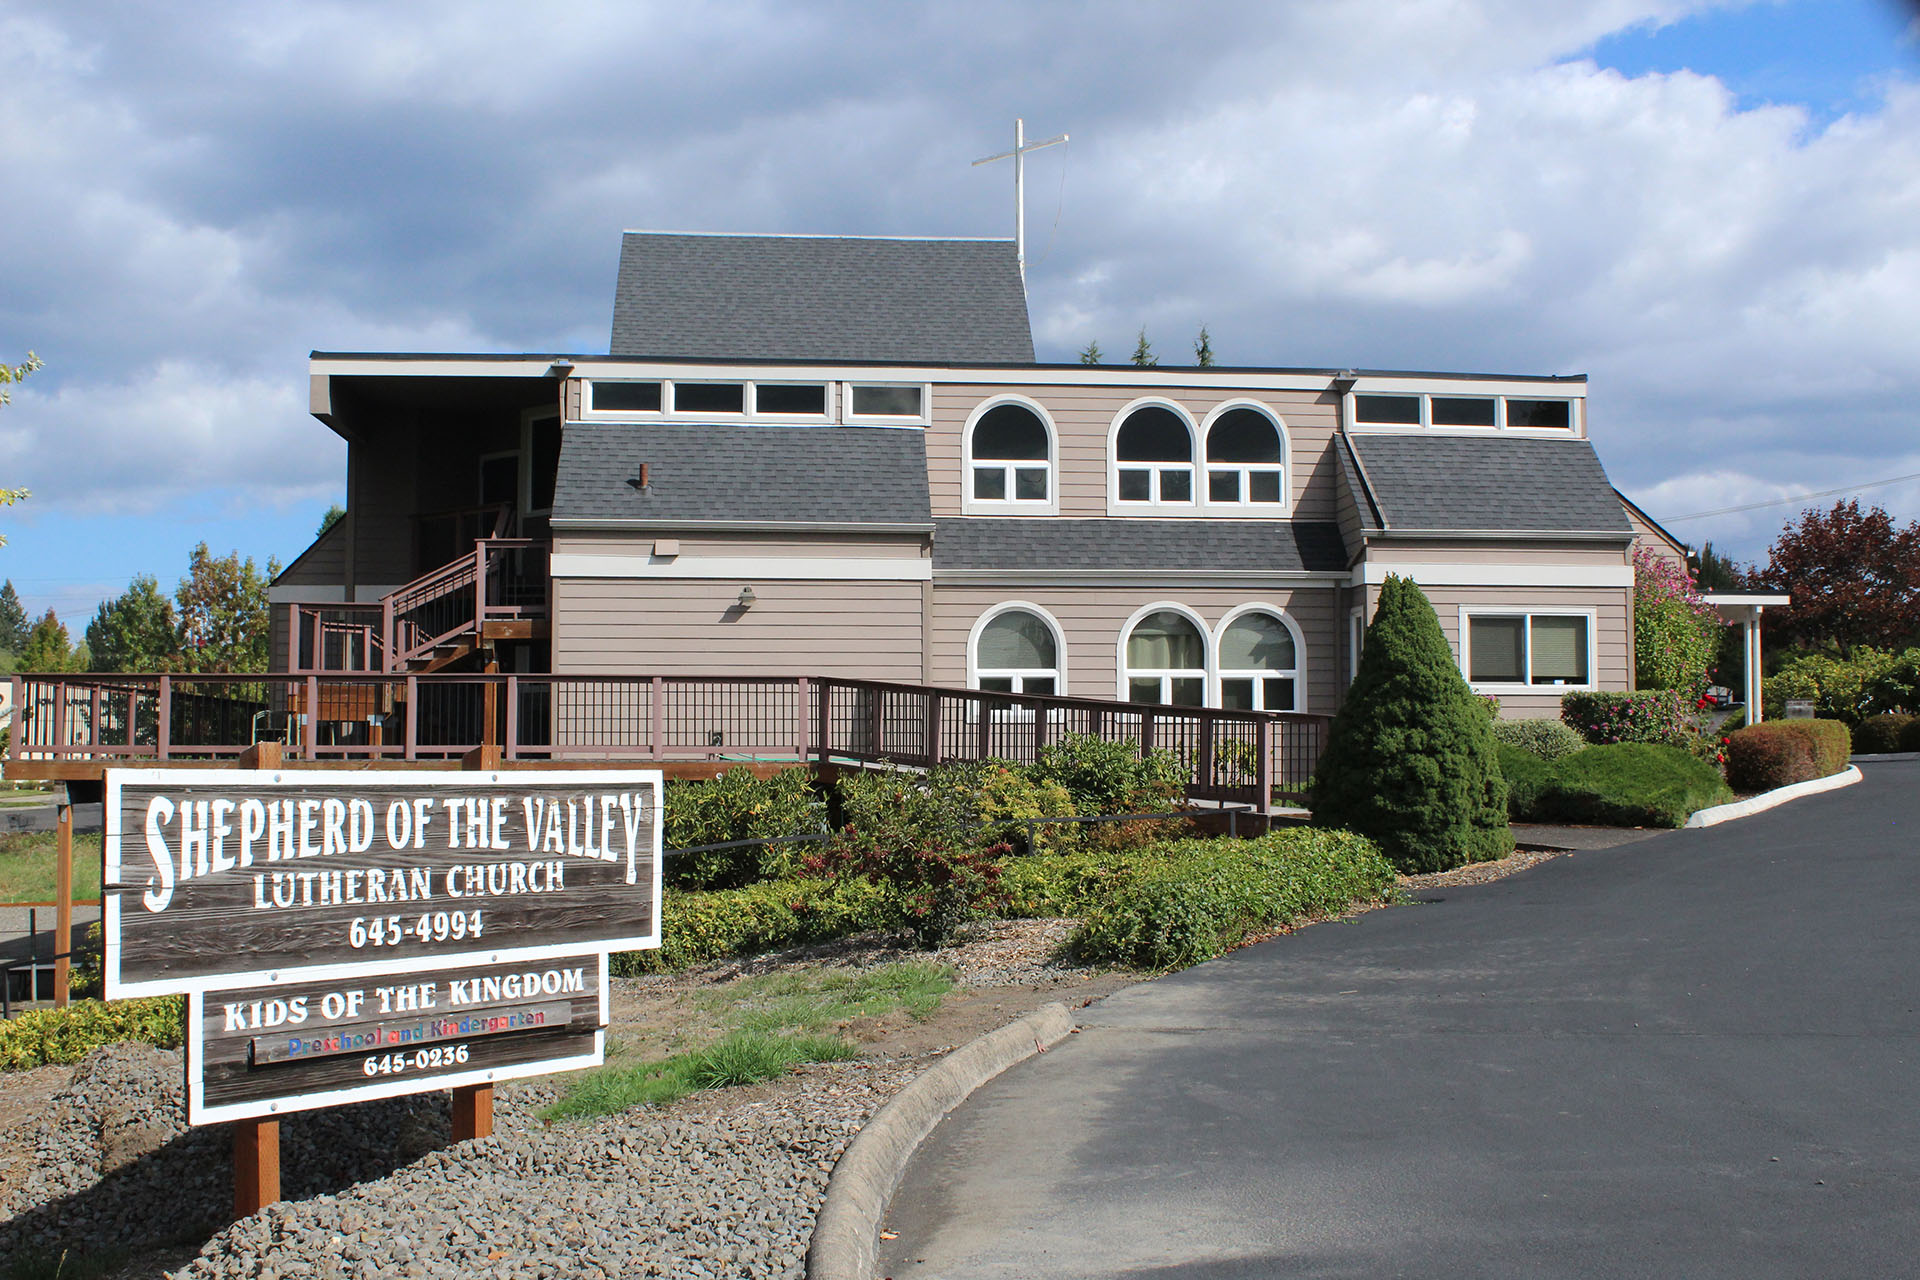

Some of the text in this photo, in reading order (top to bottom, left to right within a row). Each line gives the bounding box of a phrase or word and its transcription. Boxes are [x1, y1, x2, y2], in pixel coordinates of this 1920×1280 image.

[143, 793, 643, 913] SHEPHERD OF THE VALLEY
[253, 861, 565, 910] LUTHERAN CHURCH
[350, 909, 484, 949] 645-4994
[224, 968, 584, 1032] KIDS OF THE KINGDOM
[288, 1010, 545, 1057] Preschool and Kindergarten
[364, 1044, 469, 1077] 645-0236
